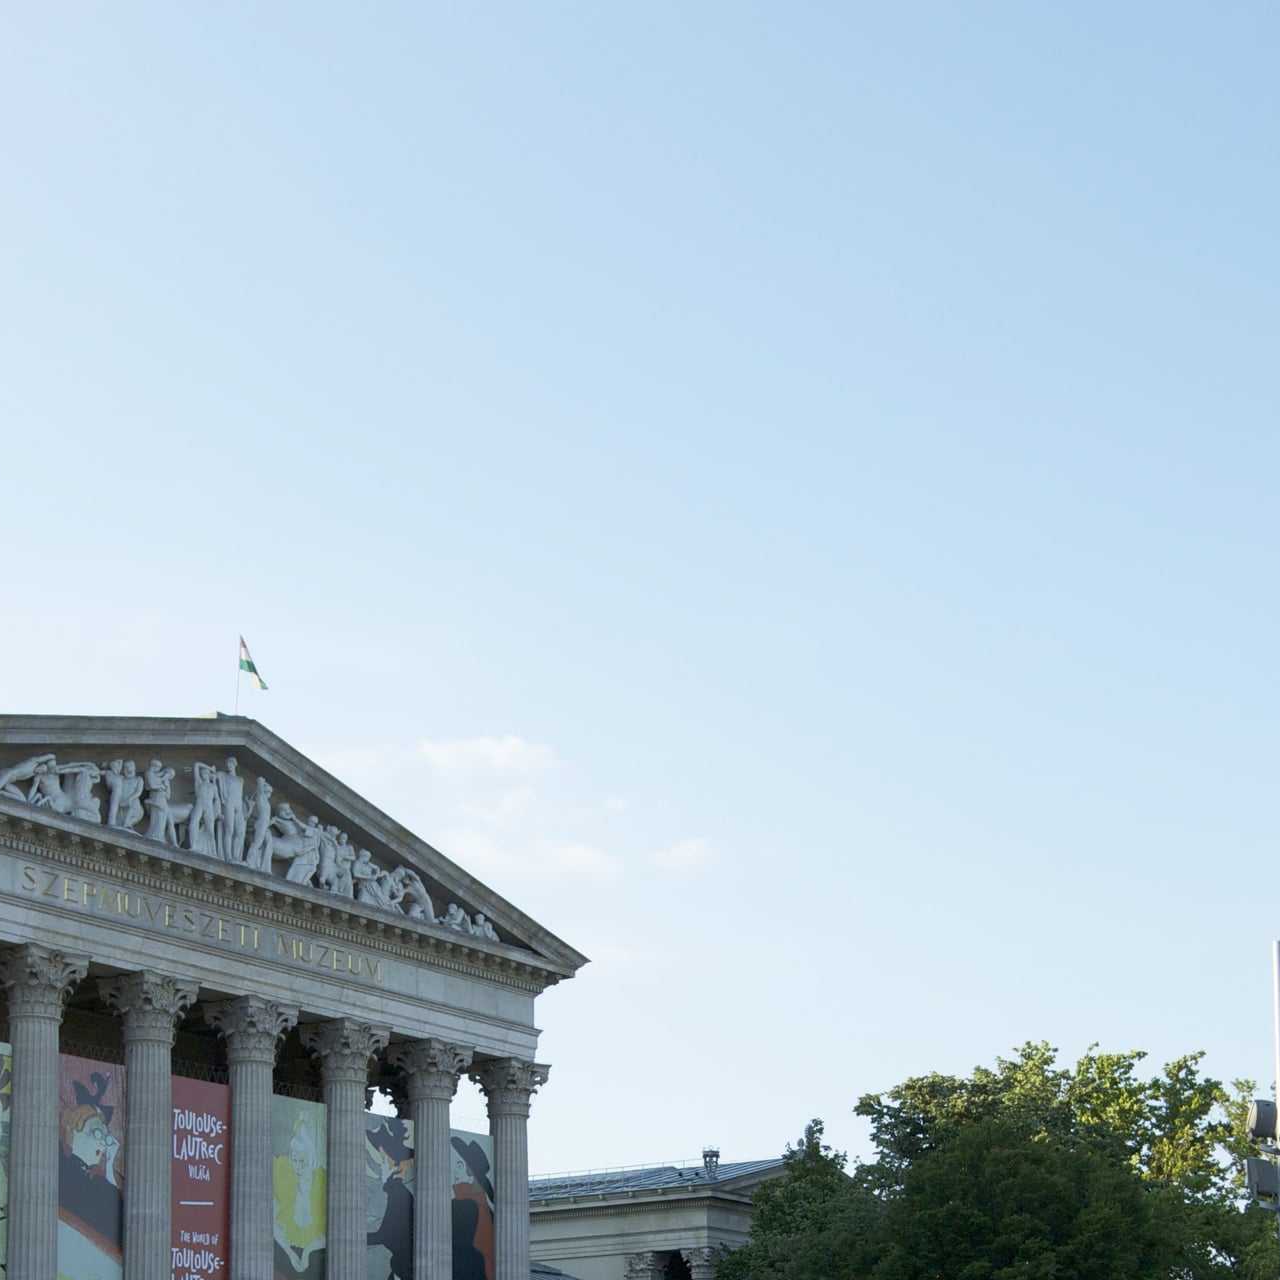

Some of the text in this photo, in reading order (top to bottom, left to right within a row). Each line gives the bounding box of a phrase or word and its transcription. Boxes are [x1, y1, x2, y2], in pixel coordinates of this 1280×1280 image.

[173, 1108, 227, 1137] TOULOUSE-
[173, 1134, 223, 1165] LAUTREC
[180, 1230, 191, 1243] THE
[171, 1247, 224, 1274] TOULOUSE-
